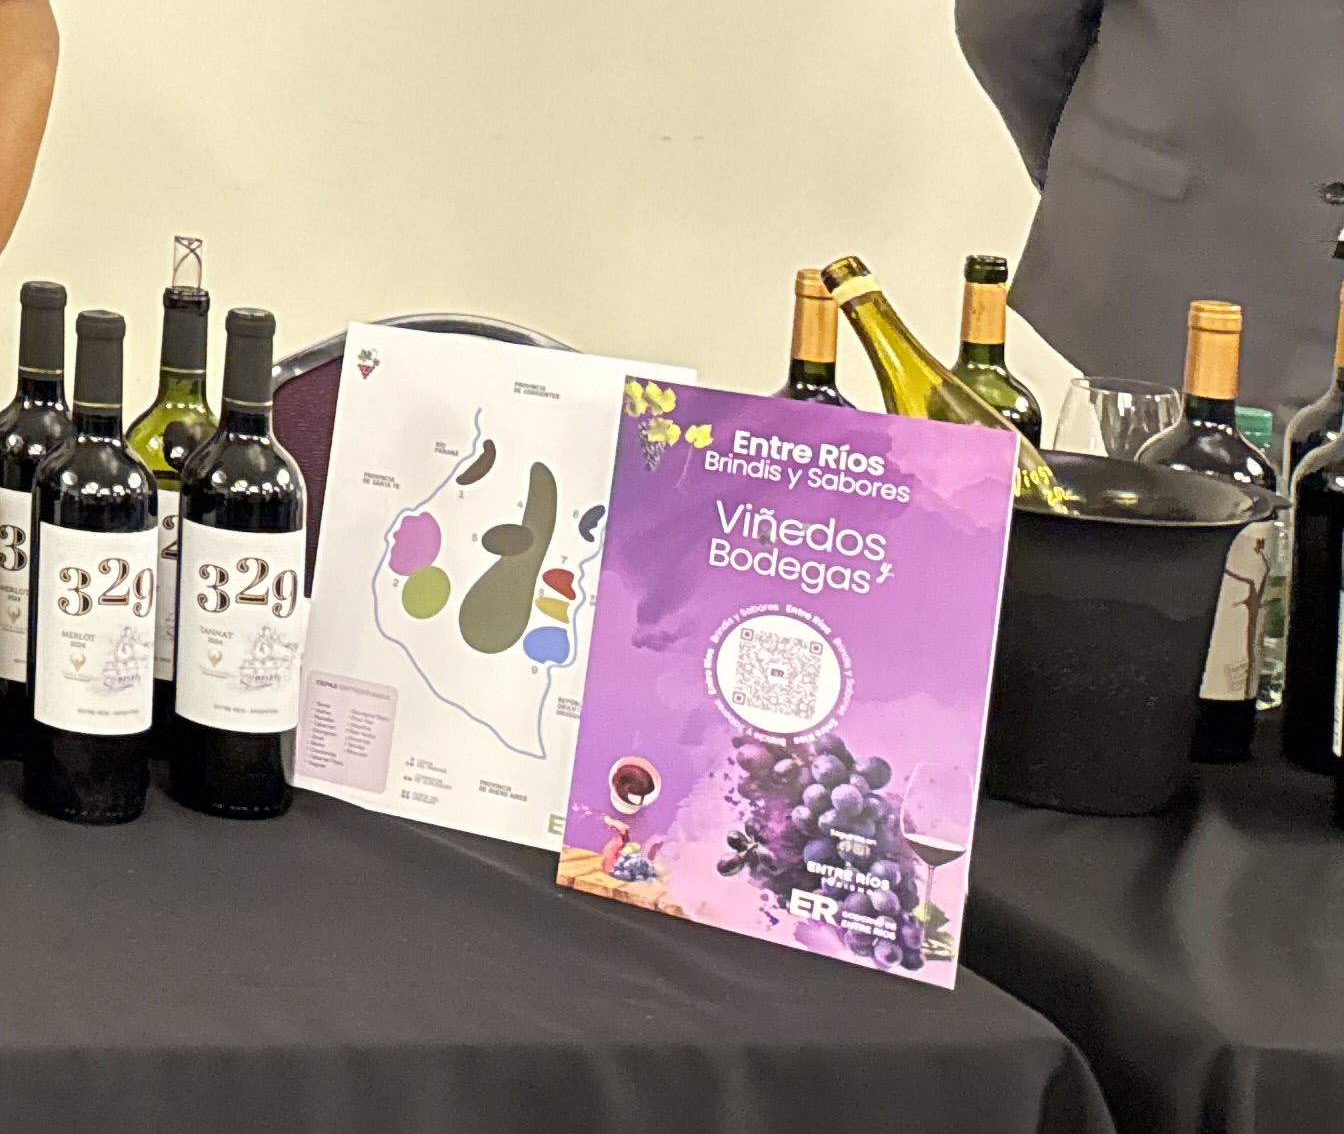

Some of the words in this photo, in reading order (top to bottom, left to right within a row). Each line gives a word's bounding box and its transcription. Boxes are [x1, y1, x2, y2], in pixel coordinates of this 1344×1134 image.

[733, 430, 812, 464] Entre
[818, 443, 885, 476] Ríos
[704, 451, 781, 481] Brindis
[788, 468, 802, 489] y
[808, 468, 910, 502] Sabores
[716, 500, 886, 561] Viñedos
[58, 557, 154, 618] 329
[197, 557, 298, 618] 329
[392, 579, 399, 588] 2
[709, 538, 871, 594] Bodegas
[62, 631, 96, 642] MERLOT
[200, 625, 234, 640] TANNAT
[807, 860, 853, 883] ENTRE
[790, 888, 838, 926] ER
